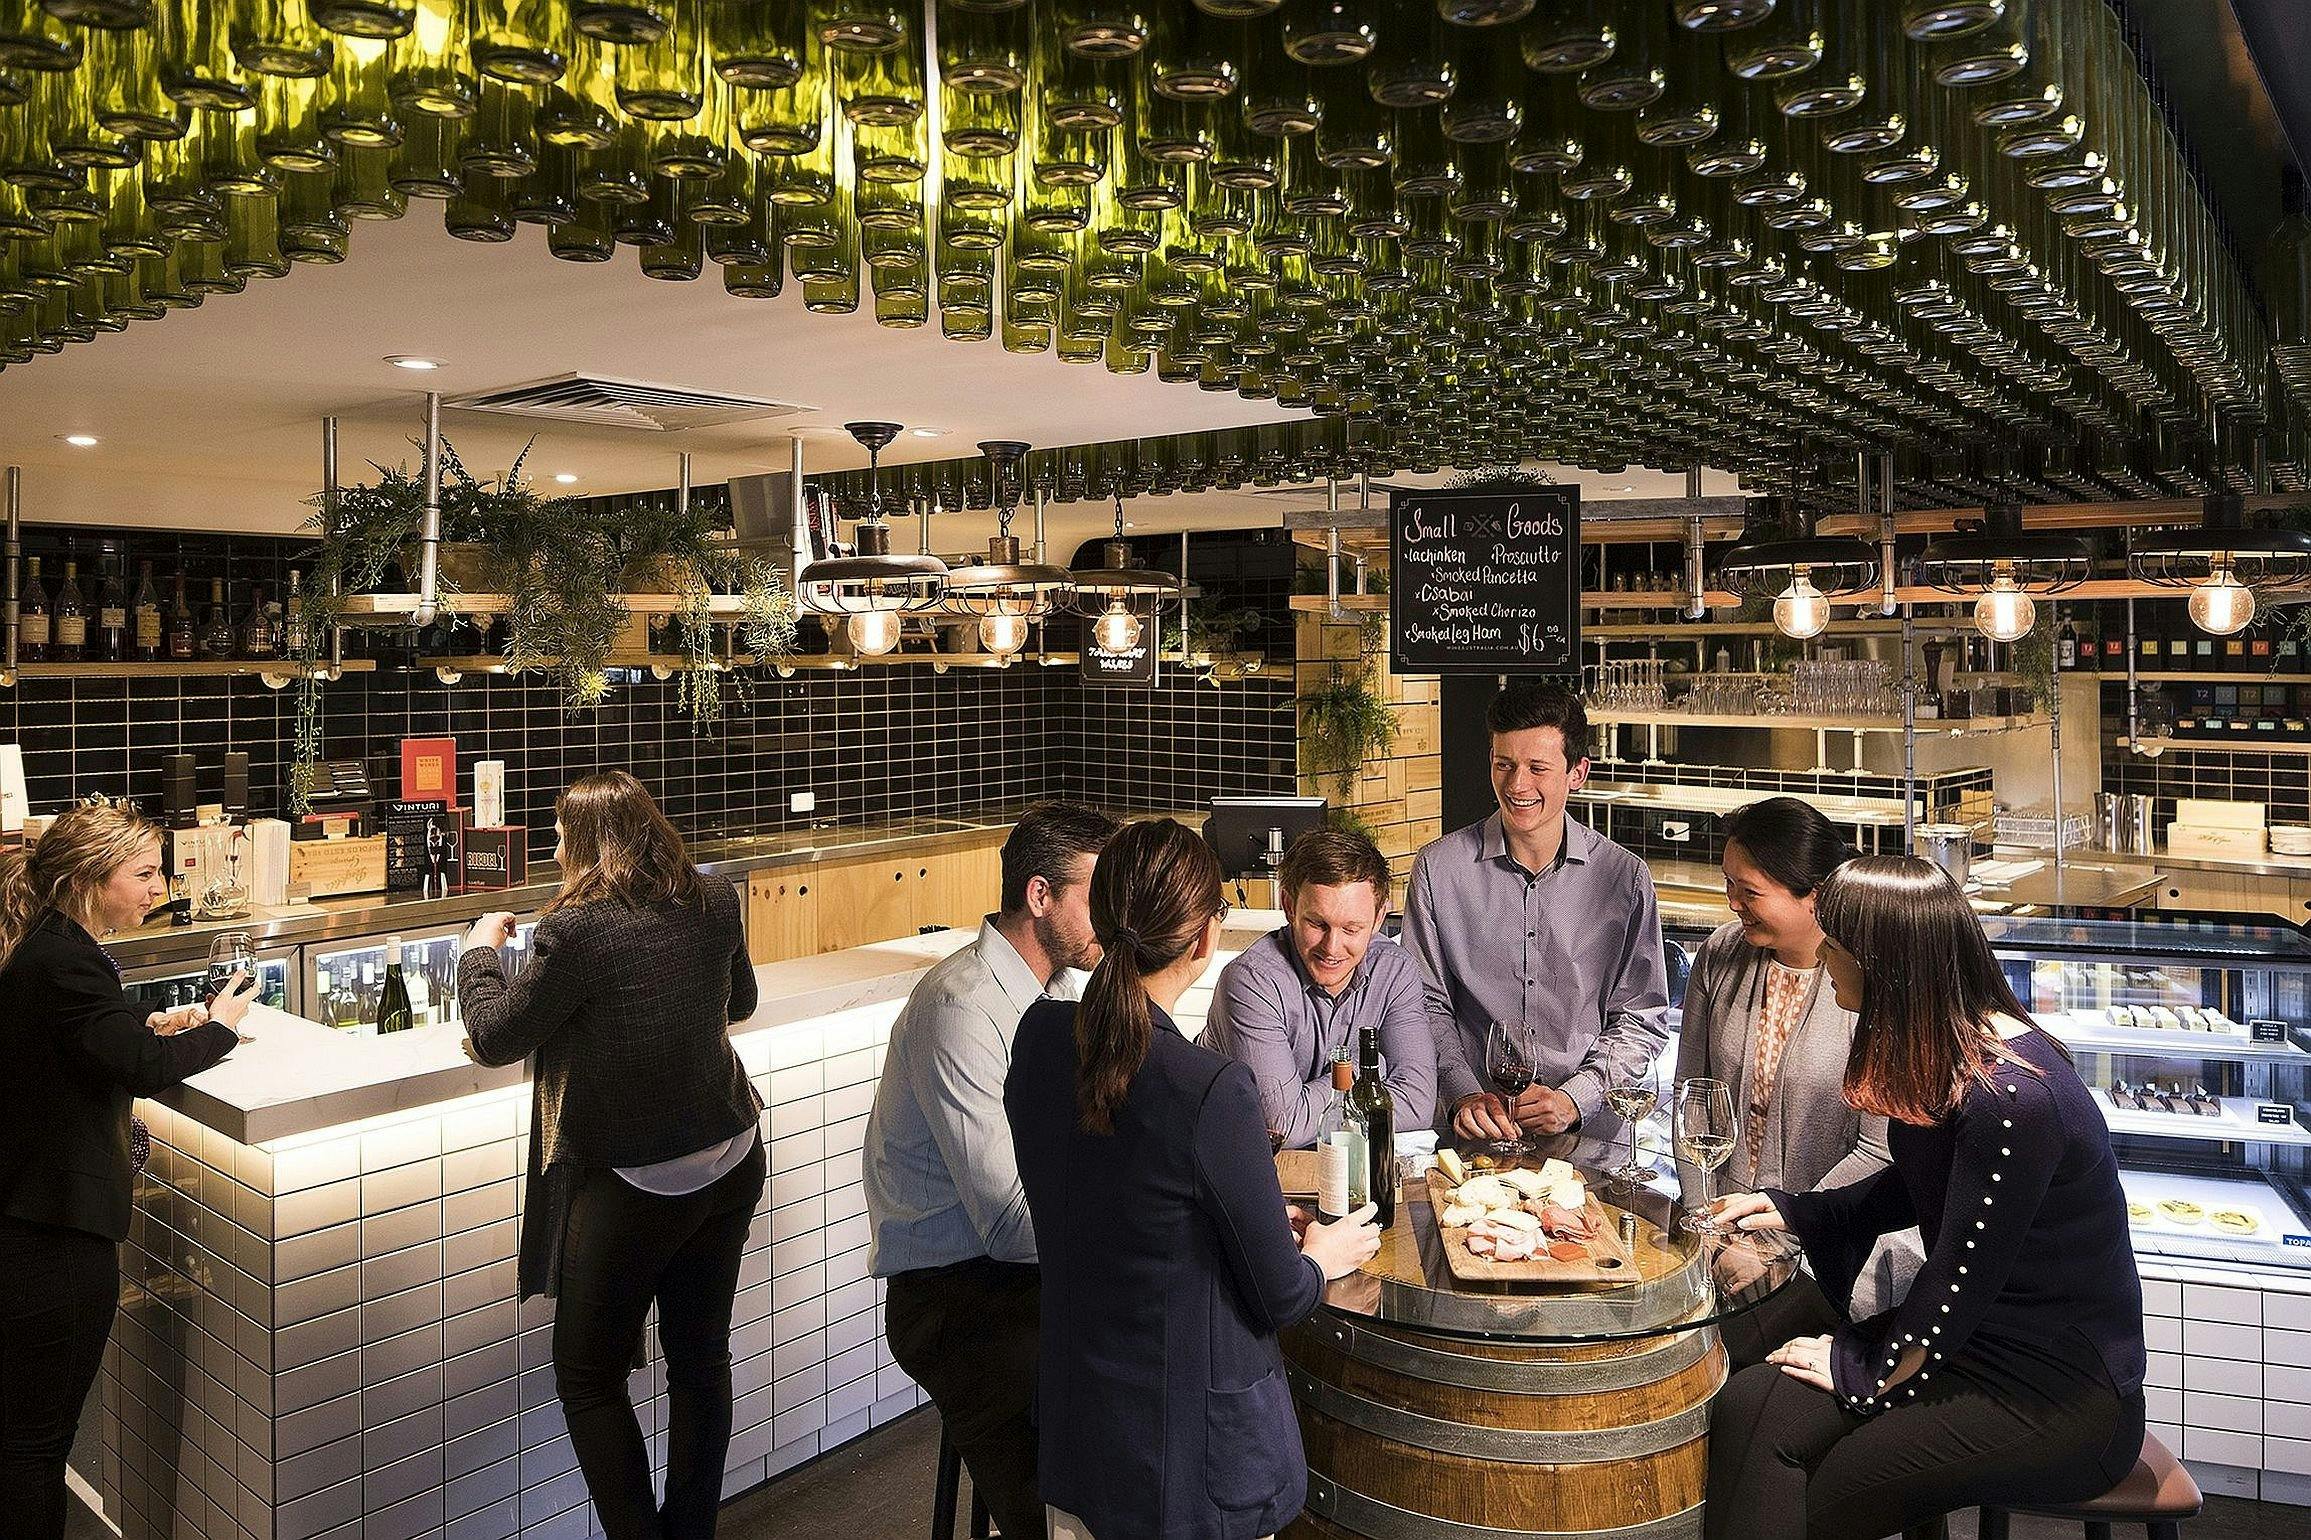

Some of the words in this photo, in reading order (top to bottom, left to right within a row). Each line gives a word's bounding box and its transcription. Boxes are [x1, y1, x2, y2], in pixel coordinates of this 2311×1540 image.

[1404, 507, 1457, 543] Small
[1507, 502, 1563, 539] Goods
[1493, 543, 1562, 565] Prosciutto
[1436, 566, 1480, 583] Smoked
[1421, 583, 1473, 602] Csabai
[1439, 603, 1488, 623] Smoked
[1490, 602, 1536, 618] Chorizo
[1410, 622, 1450, 643] Smoked
[1472, 624, 1502, 641] Ham
[392, 802, 440, 811] VINTURI
